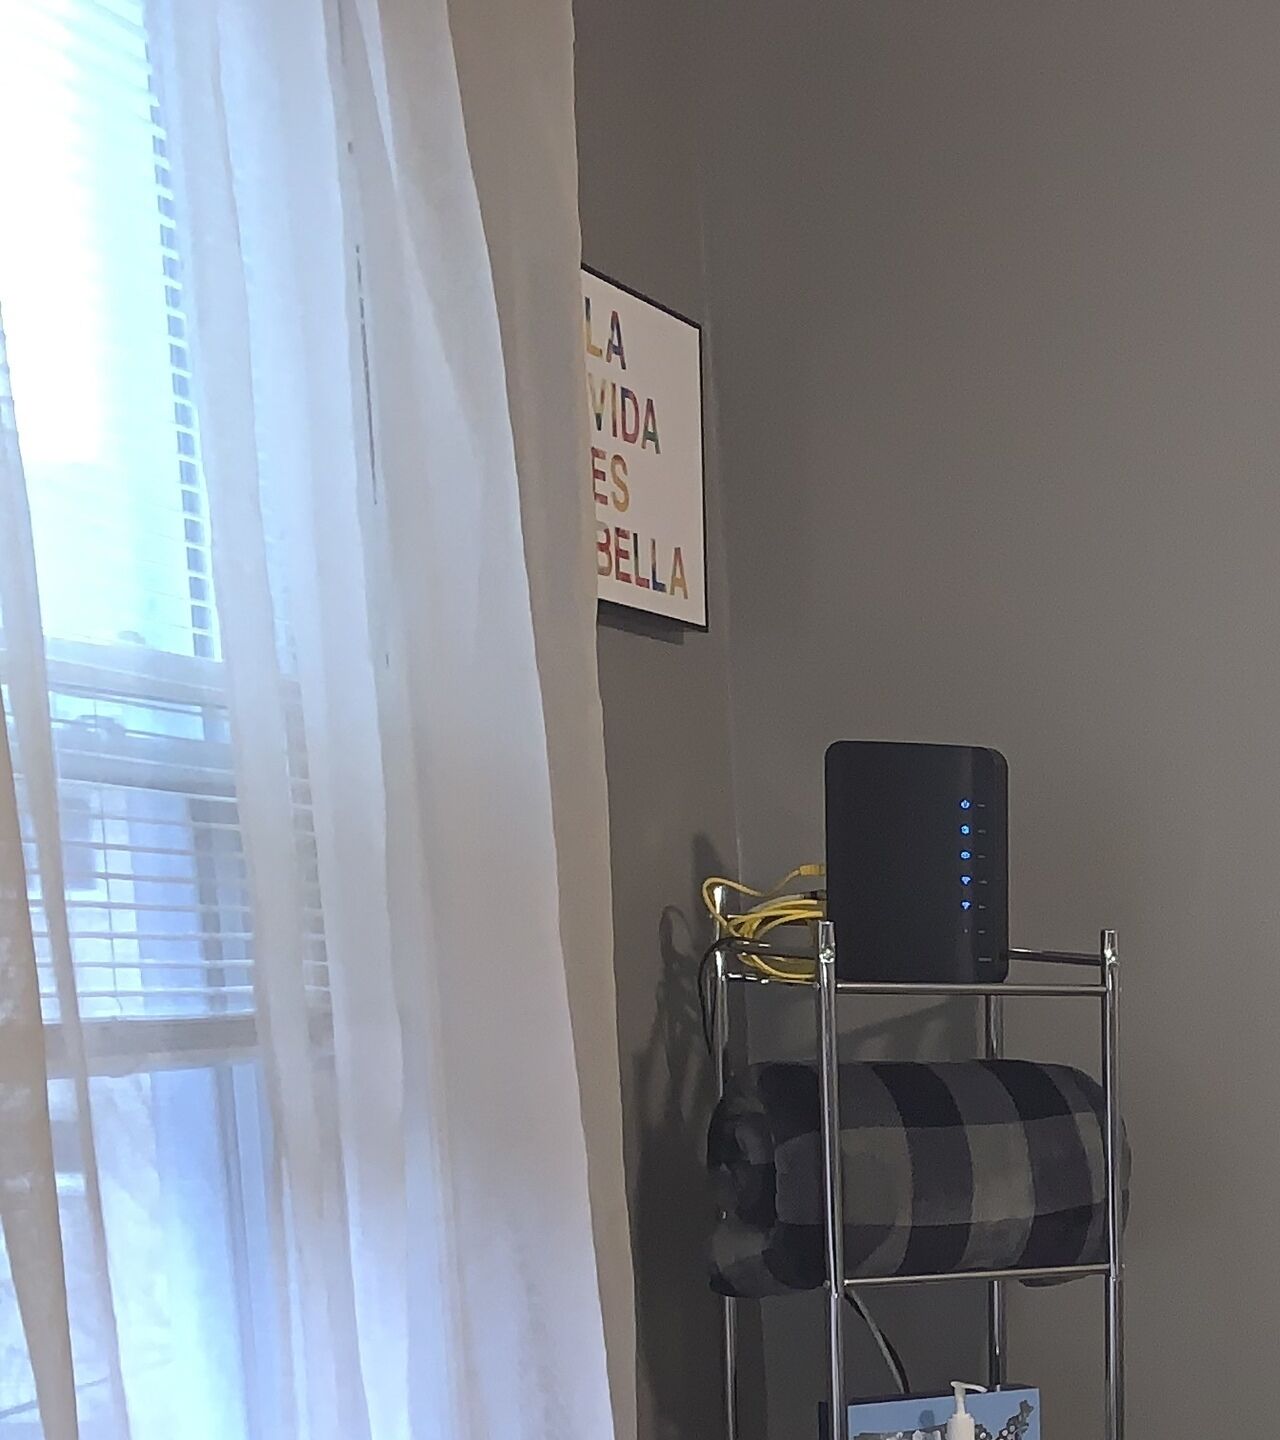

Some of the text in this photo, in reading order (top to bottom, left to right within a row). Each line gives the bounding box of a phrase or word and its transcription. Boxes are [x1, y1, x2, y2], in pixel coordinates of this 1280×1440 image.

[584, 296, 627, 370] LA
[588, 372, 661, 454] VIDA
[591, 446, 630, 513] ES
[597, 526, 689, 600] BELLA
